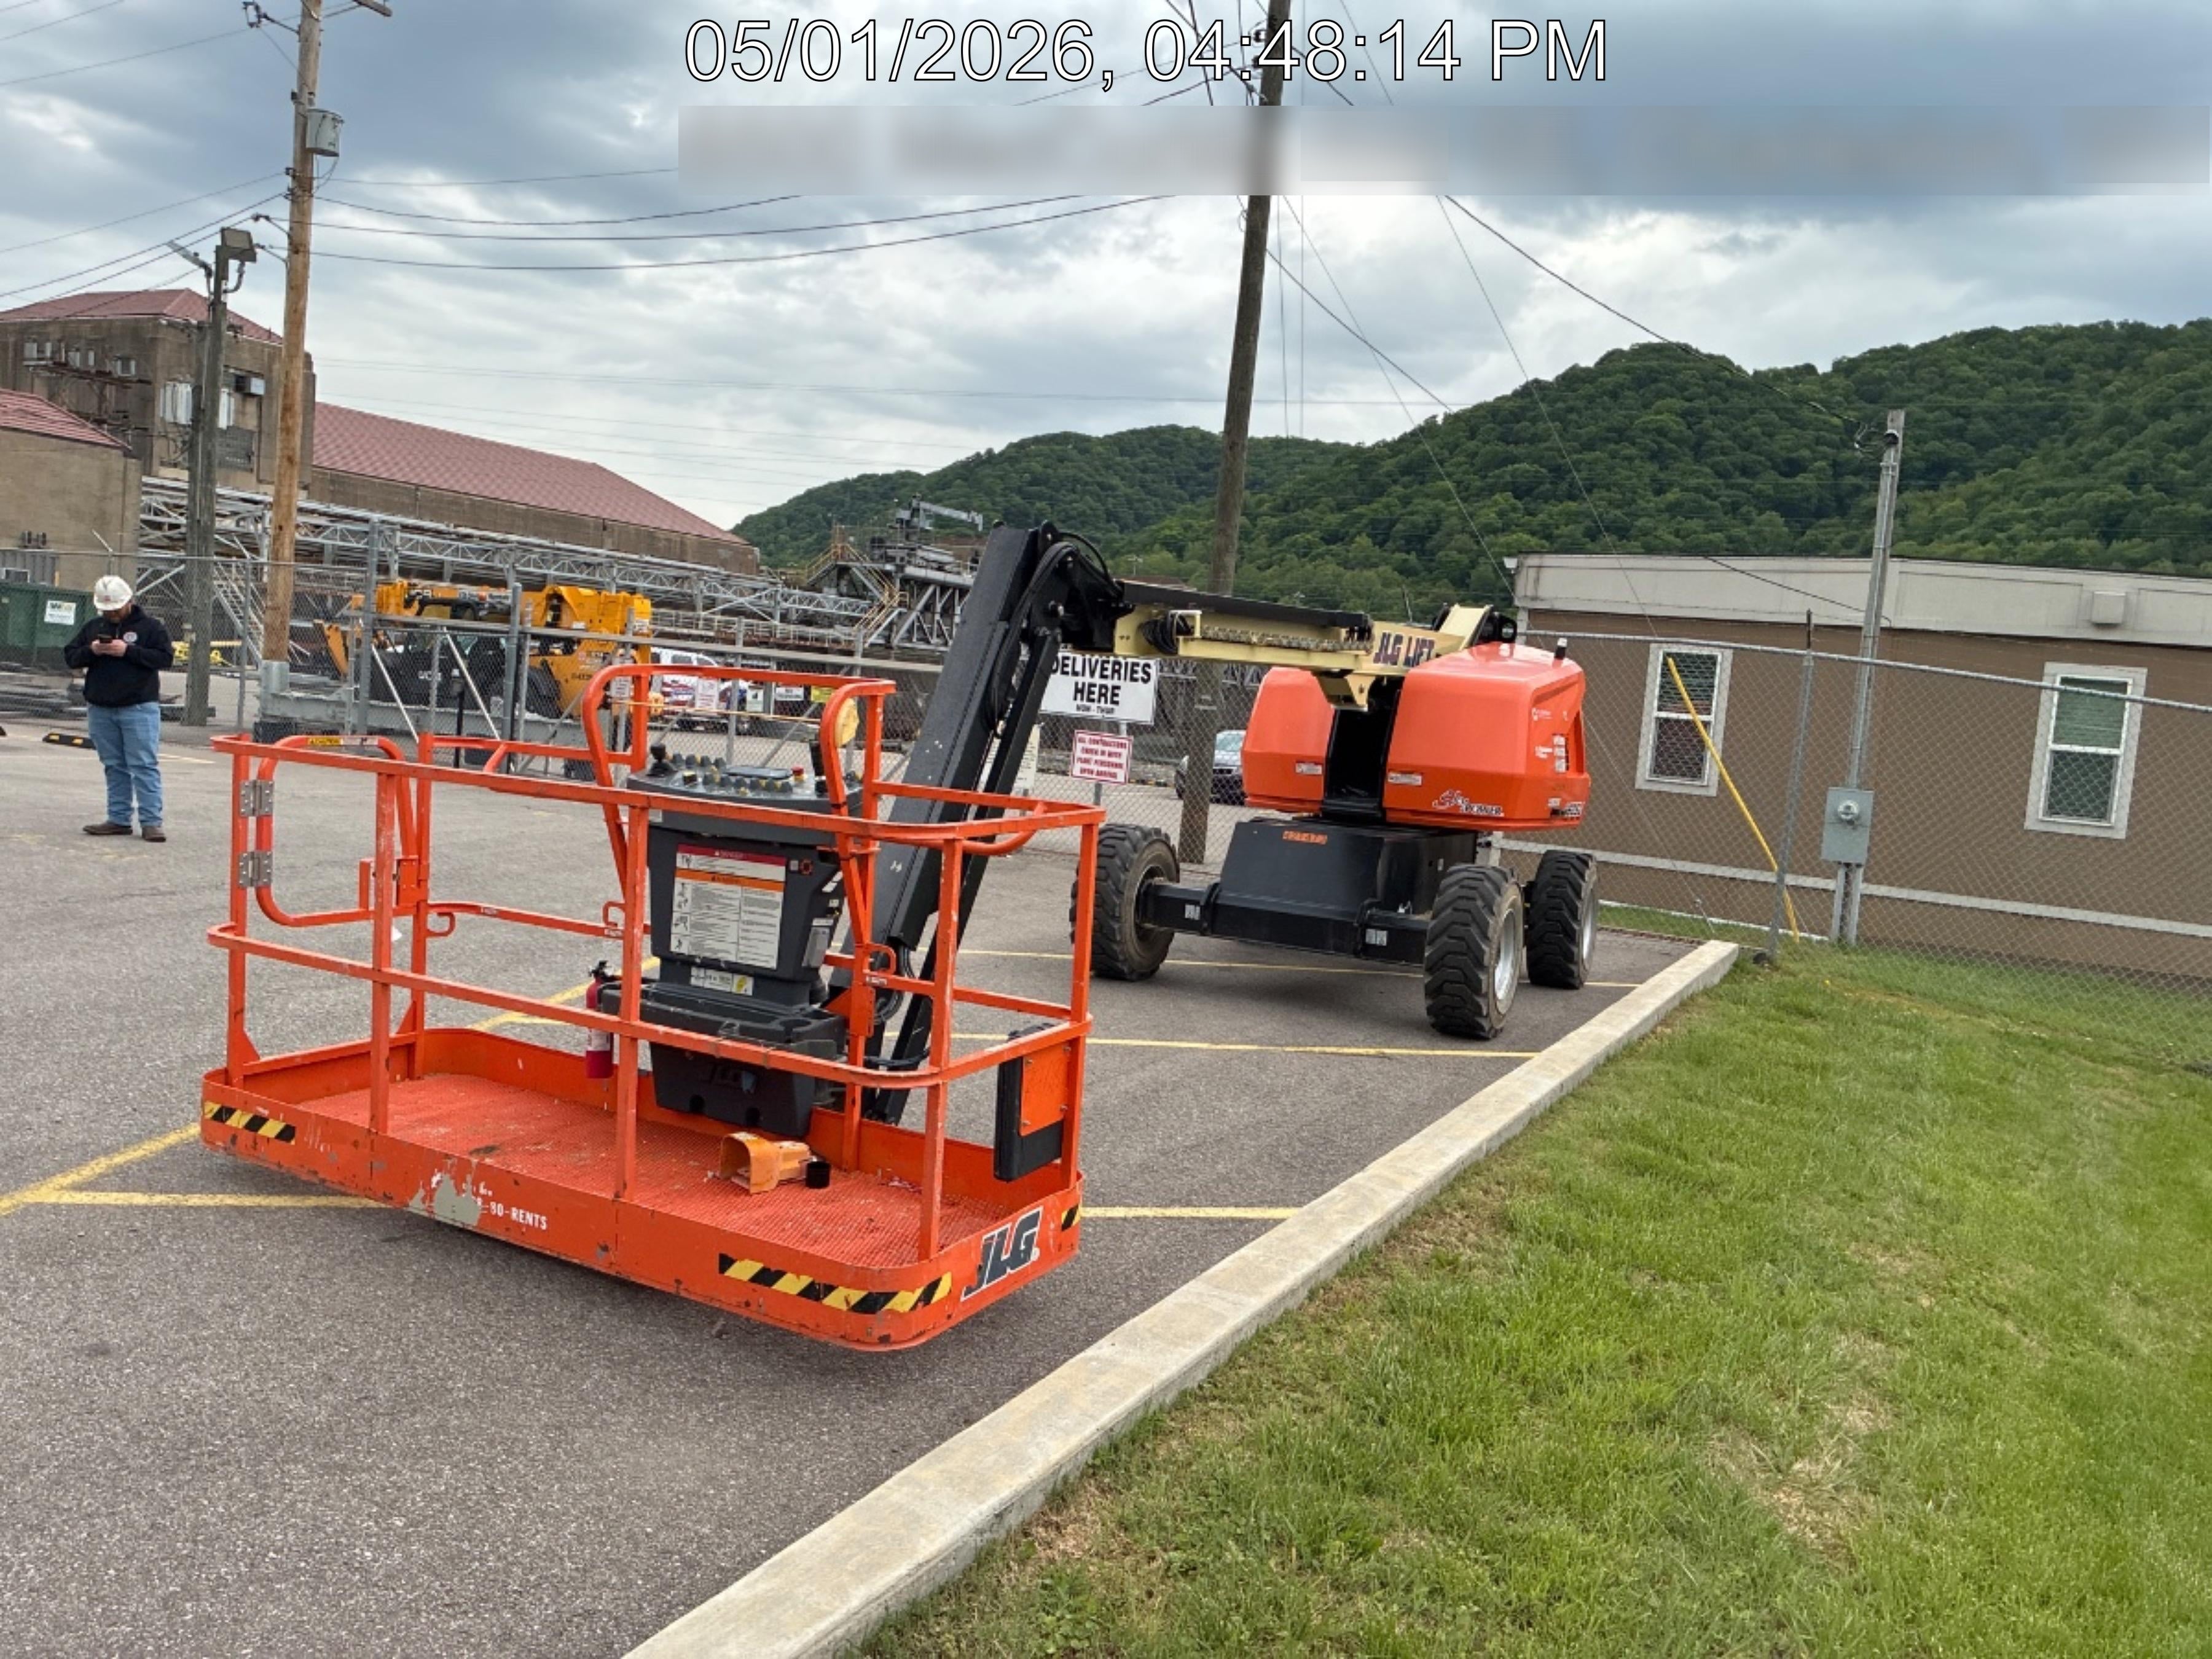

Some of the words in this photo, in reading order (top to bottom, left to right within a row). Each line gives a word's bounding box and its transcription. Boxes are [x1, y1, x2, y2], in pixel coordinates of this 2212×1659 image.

[1373, 632, 1403, 665] JLG
[1051, 655, 1151, 684] DELIVERIES
[1073, 681, 1121, 706] HERE
[960, 1206, 1043, 1303] JLG
